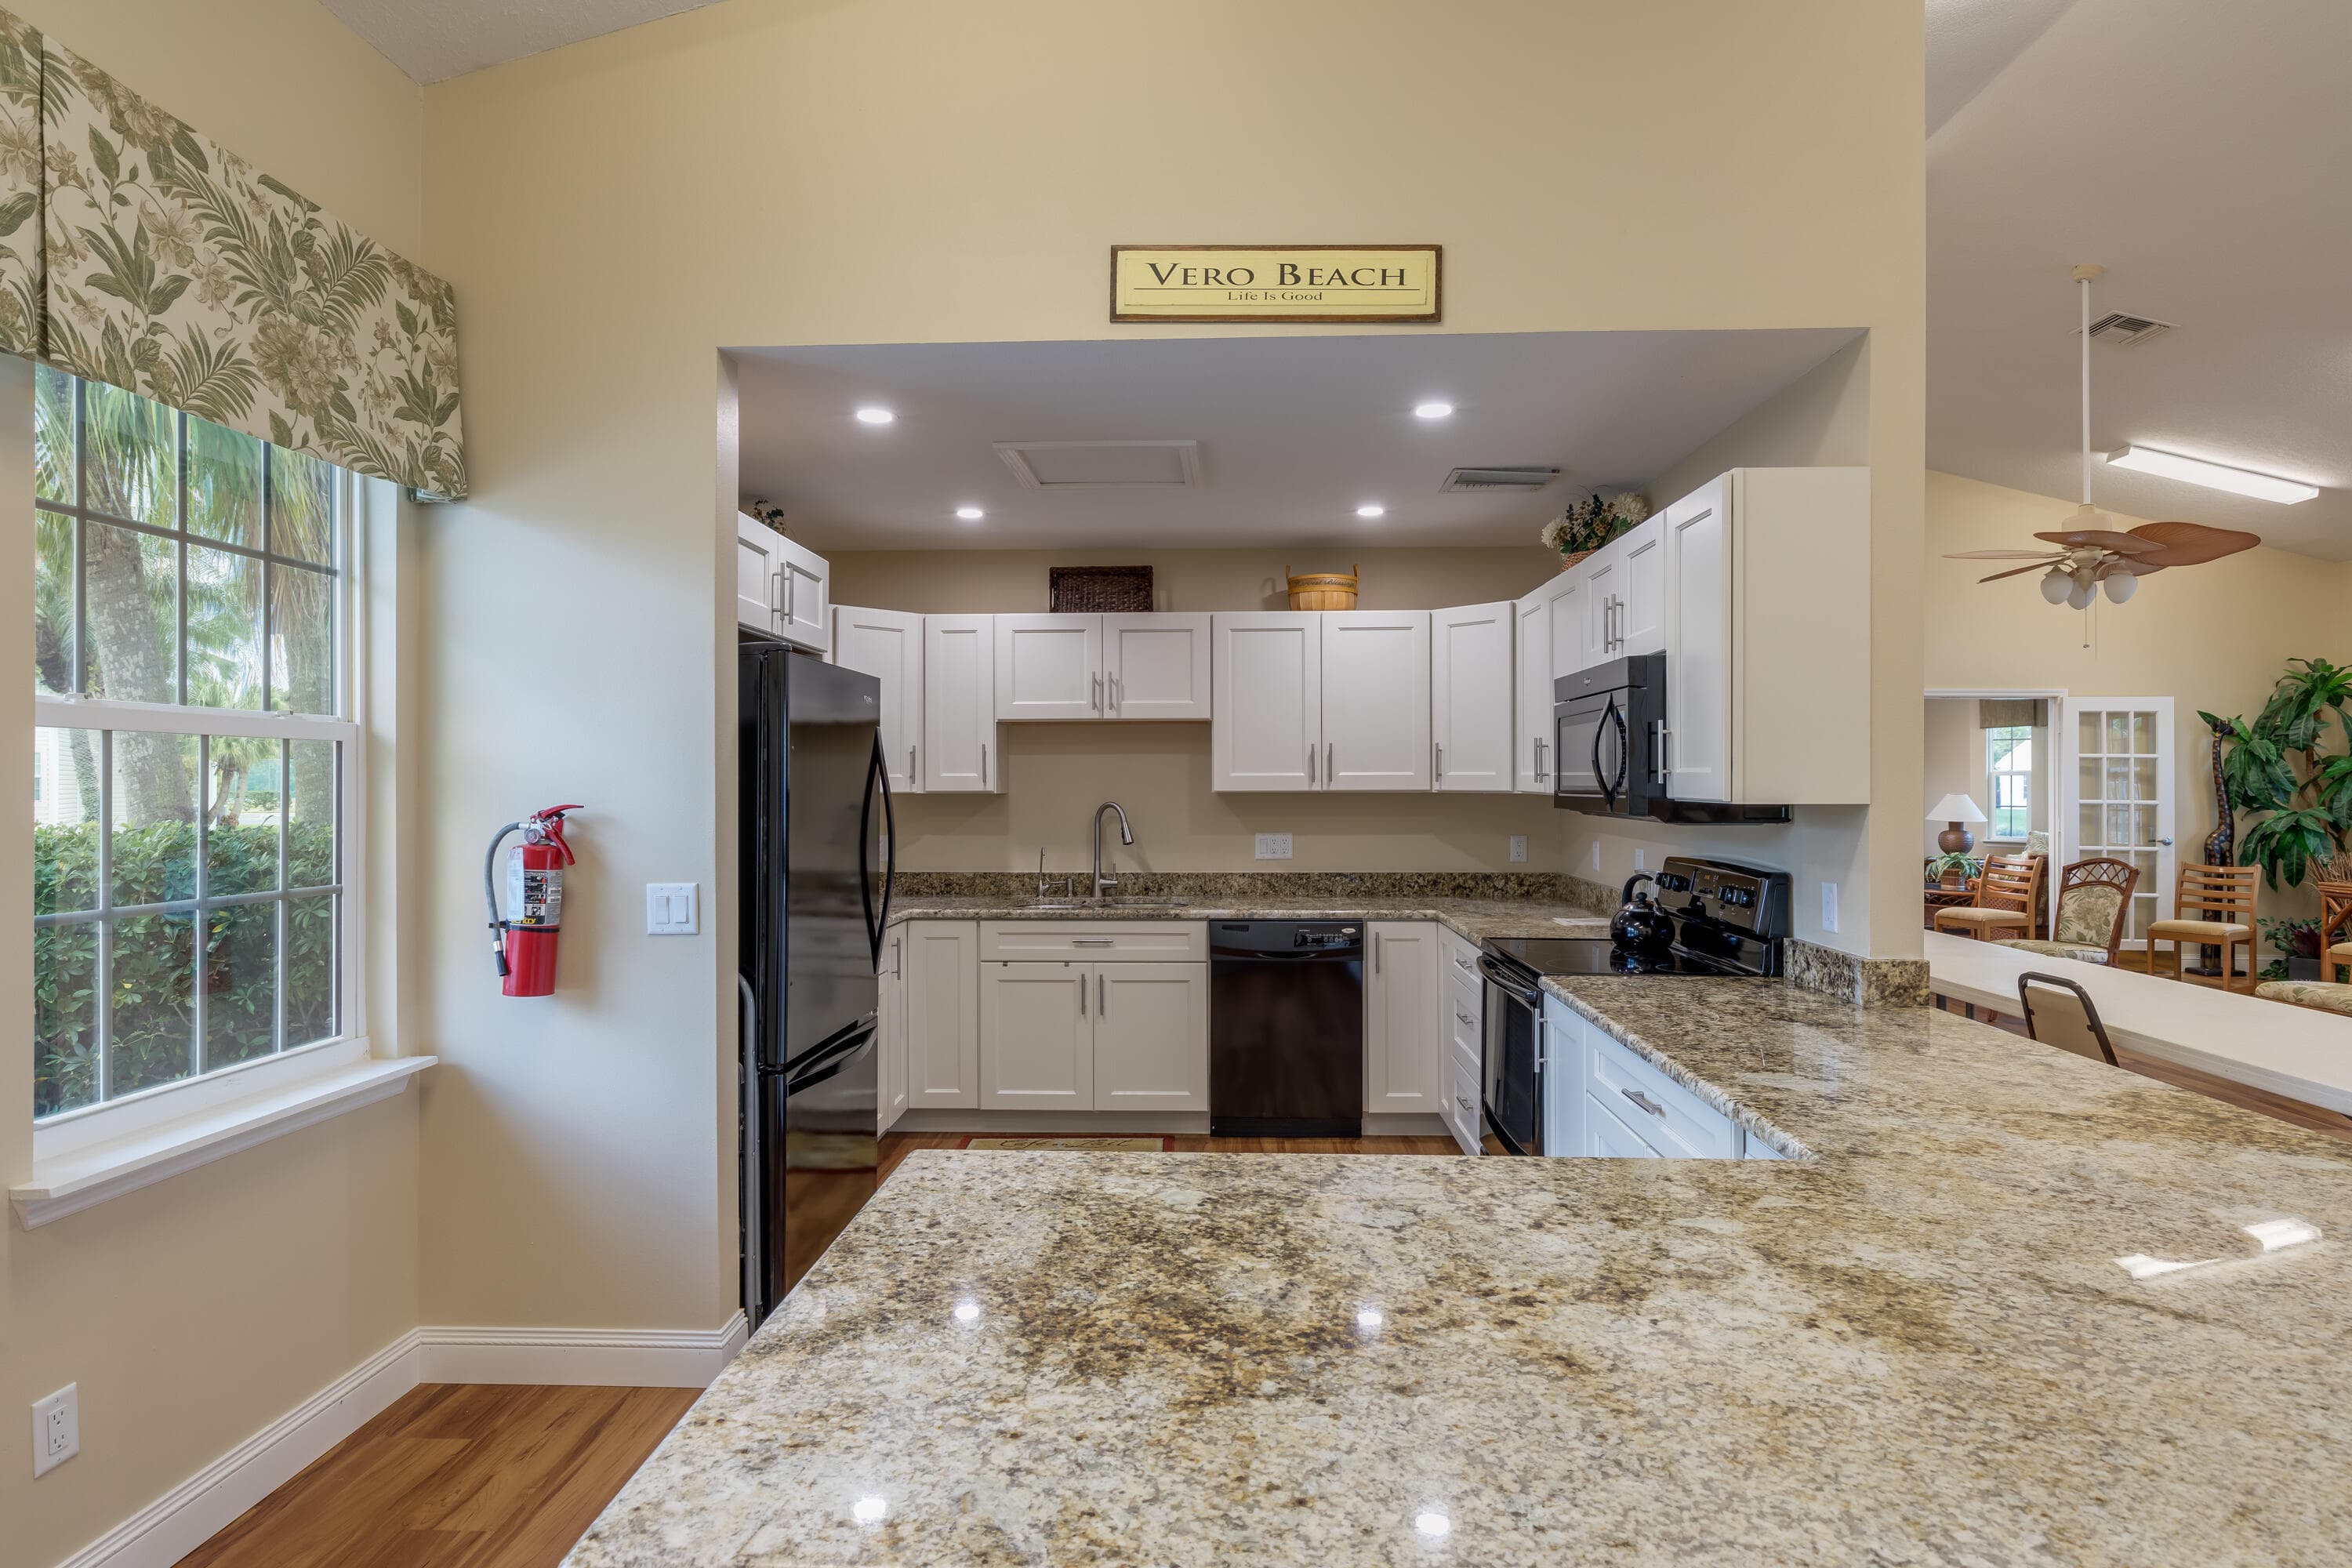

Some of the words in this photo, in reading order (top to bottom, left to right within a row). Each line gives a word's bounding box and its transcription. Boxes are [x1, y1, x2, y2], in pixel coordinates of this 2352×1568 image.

[1276, 263, 1407, 286] BEACH
[1228, 292, 1258, 300] Life
[1264, 292, 1276, 300] Is
[1281, 292, 1323, 301] Good
